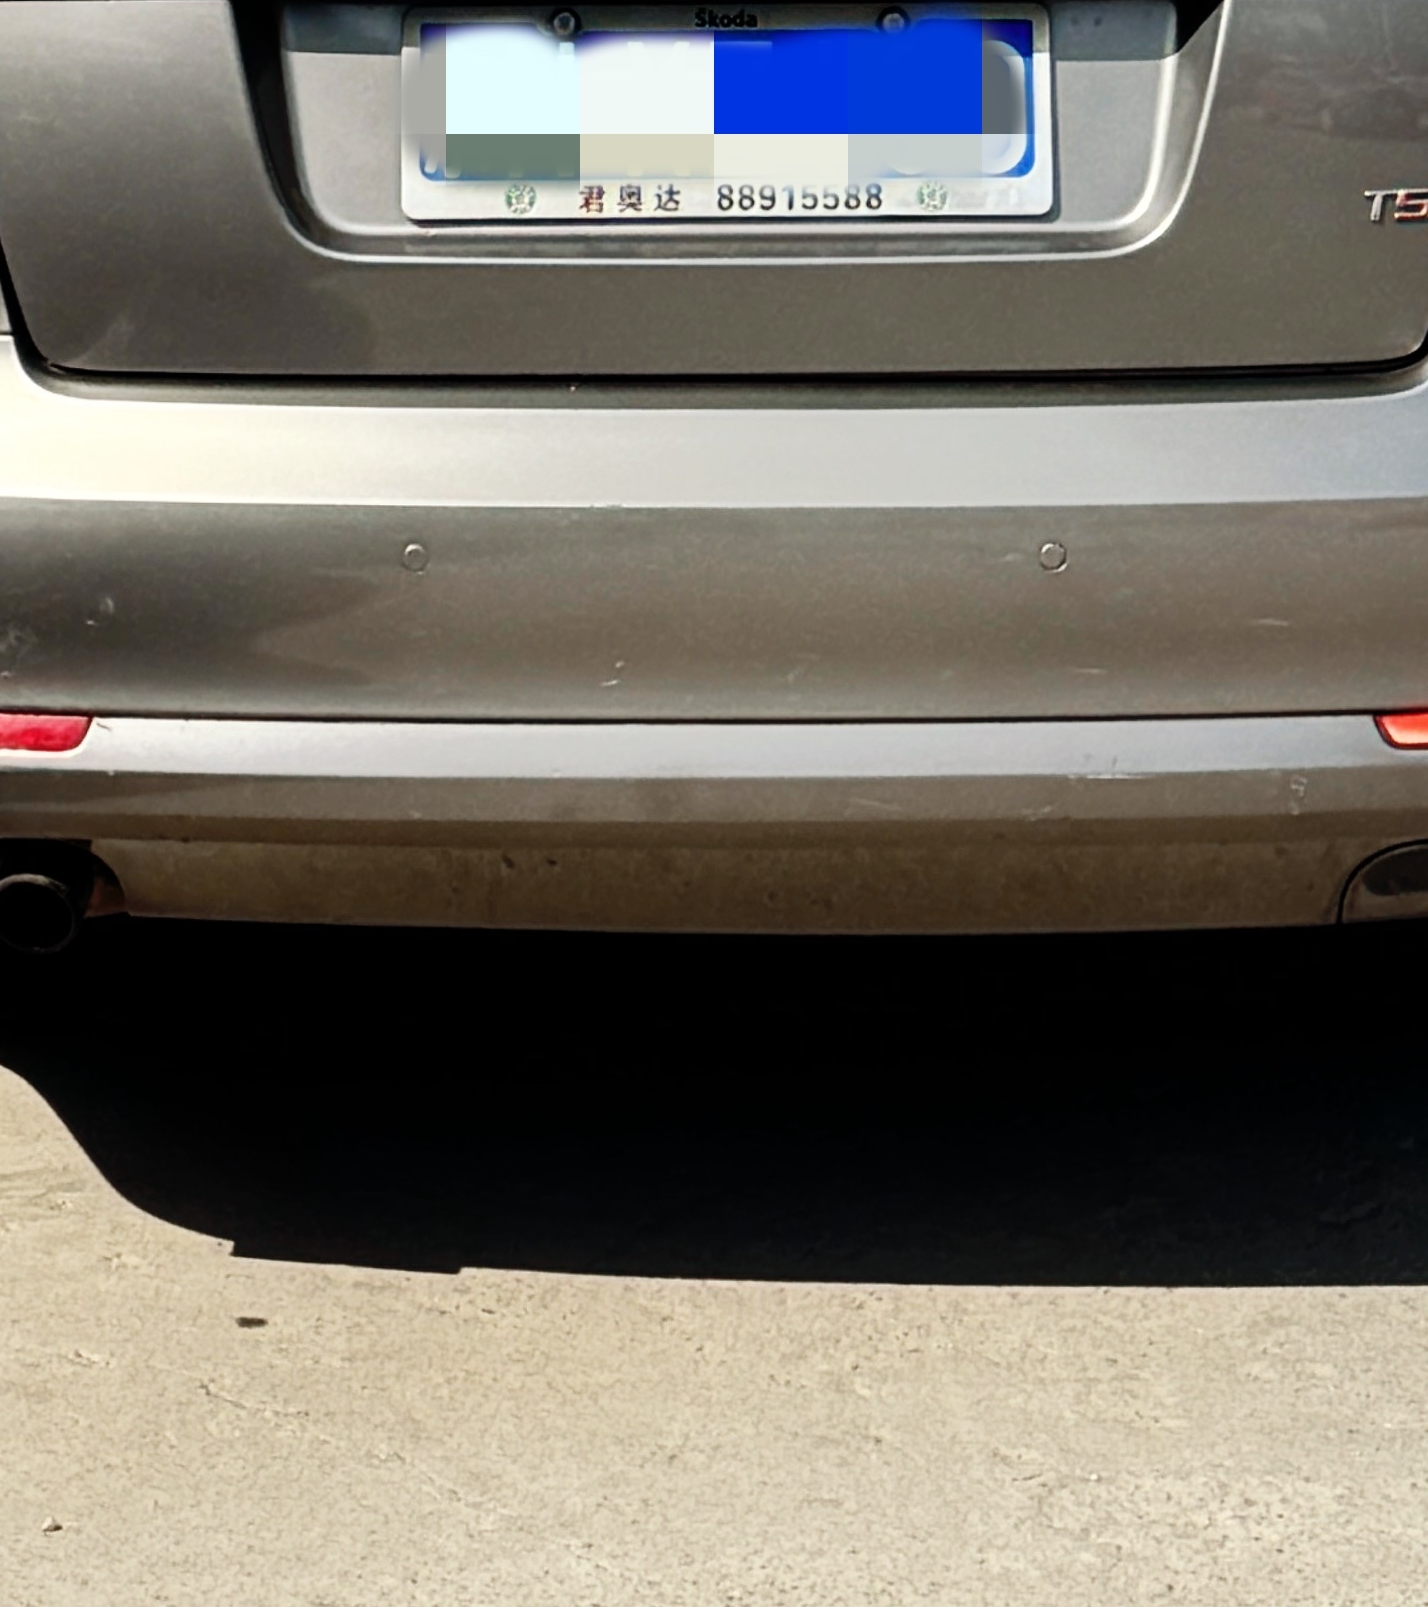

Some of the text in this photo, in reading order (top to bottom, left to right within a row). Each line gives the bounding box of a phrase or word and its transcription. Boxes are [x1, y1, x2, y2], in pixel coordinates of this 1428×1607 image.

[578, 183, 884, 214] 君奥达 88915588
